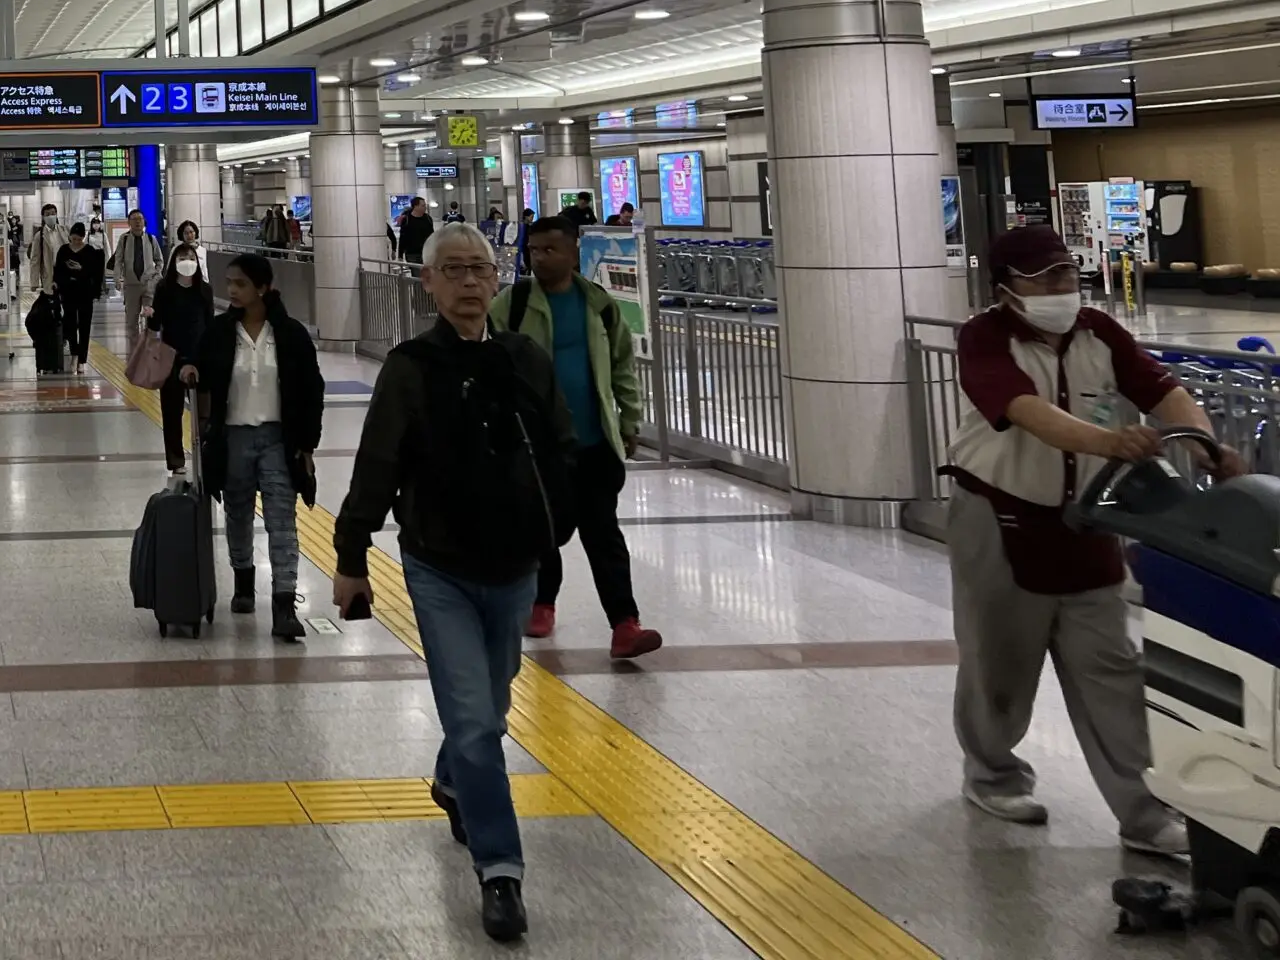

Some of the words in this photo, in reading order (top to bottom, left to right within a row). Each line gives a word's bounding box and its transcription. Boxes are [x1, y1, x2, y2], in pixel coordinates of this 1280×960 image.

[0, 86, 54, 96] アクセス特急
[228, 82, 266, 91] 京成本線
[0, 97, 29, 106] Access
[30, 96, 62, 107] Express
[145, 86, 161, 110] 2
[172, 86, 188, 110] 3
[228, 93, 253, 102] Keisei
[255, 93, 277, 101] Main
[279, 93, 298, 101] Line
[0, 107, 25, 115] Access
[1053, 103, 1084, 114] 待合室
